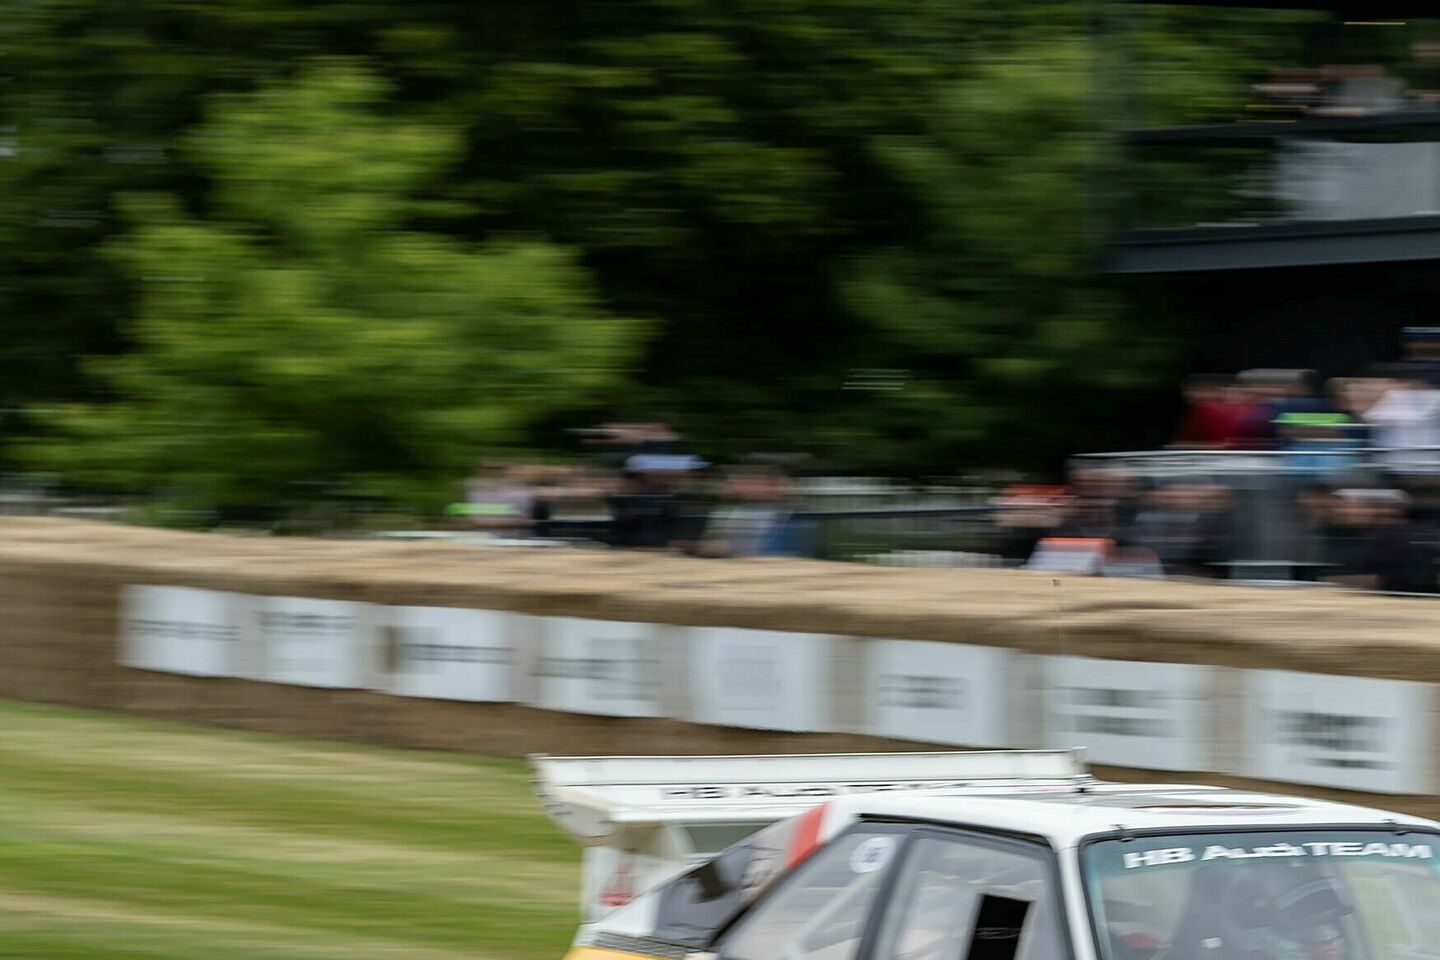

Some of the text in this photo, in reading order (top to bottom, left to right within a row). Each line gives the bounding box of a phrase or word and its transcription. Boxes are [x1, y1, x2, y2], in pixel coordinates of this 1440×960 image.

[1124, 842, 1433, 869] HB Audi TEAM
